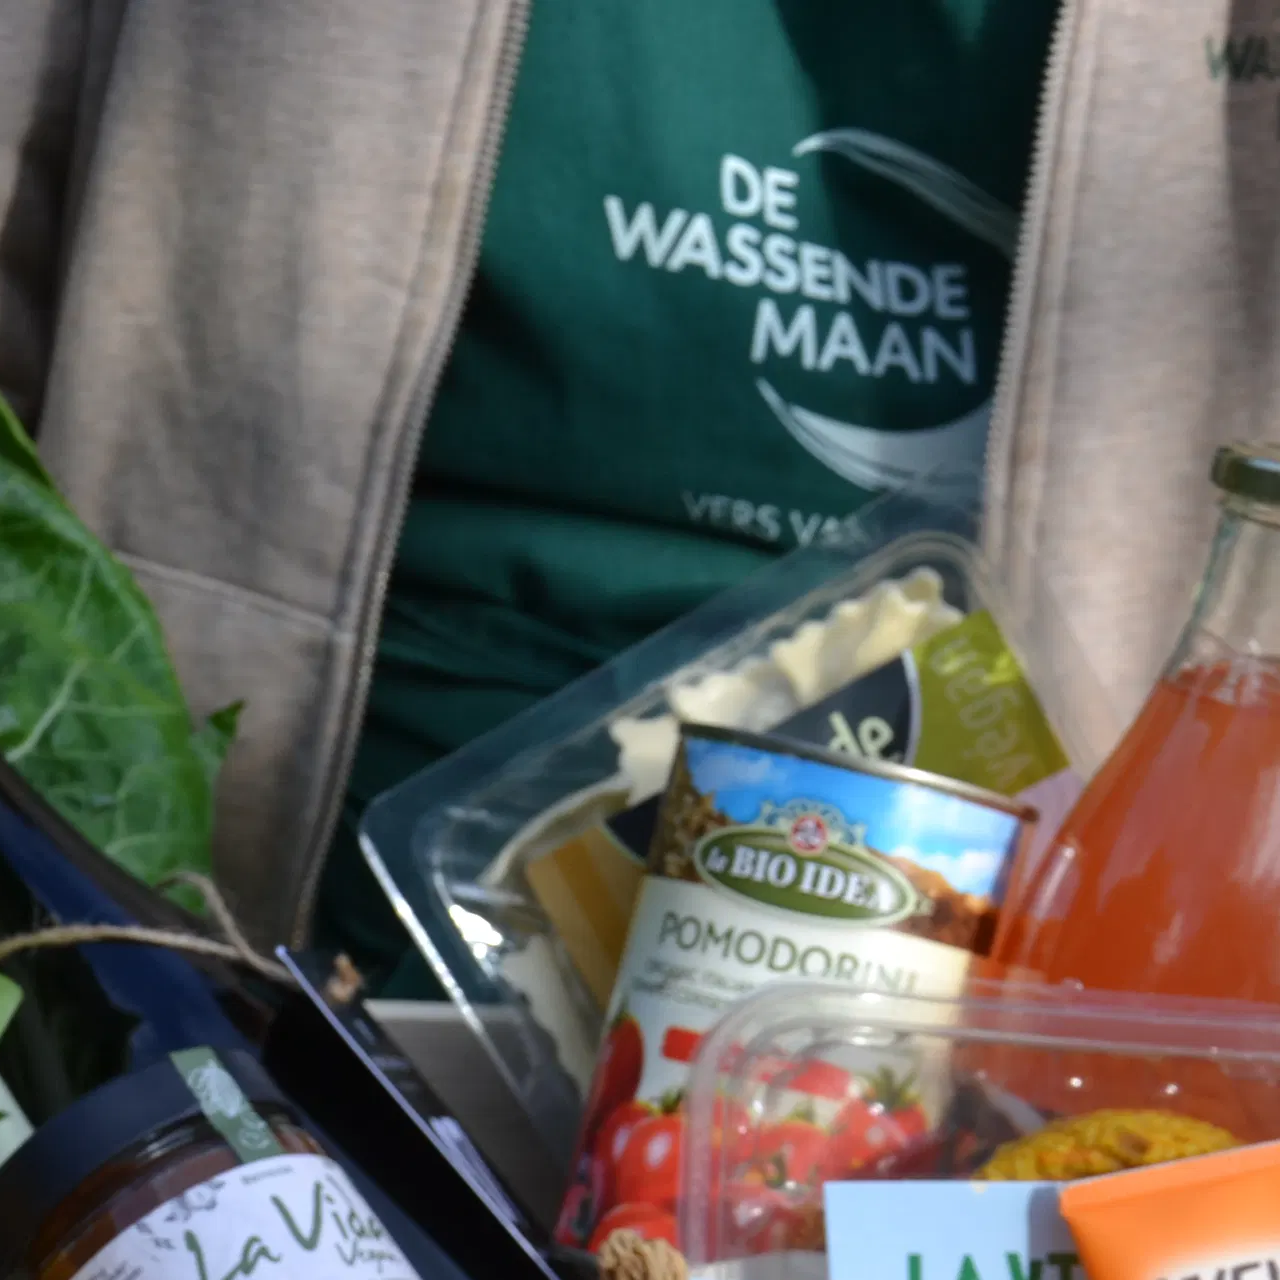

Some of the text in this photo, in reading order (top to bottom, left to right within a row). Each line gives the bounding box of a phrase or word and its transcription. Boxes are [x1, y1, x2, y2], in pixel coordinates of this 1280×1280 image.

[721, 152, 800, 230] DE
[603, 194, 970, 319] WASSENDE
[750, 298, 977, 384] MAAN
[730, 844, 798, 891] BIO
[800, 860, 900, 910] IDEA
[658, 908, 920, 997] POMODORINI
[271, 1180, 390, 1252] Vida
